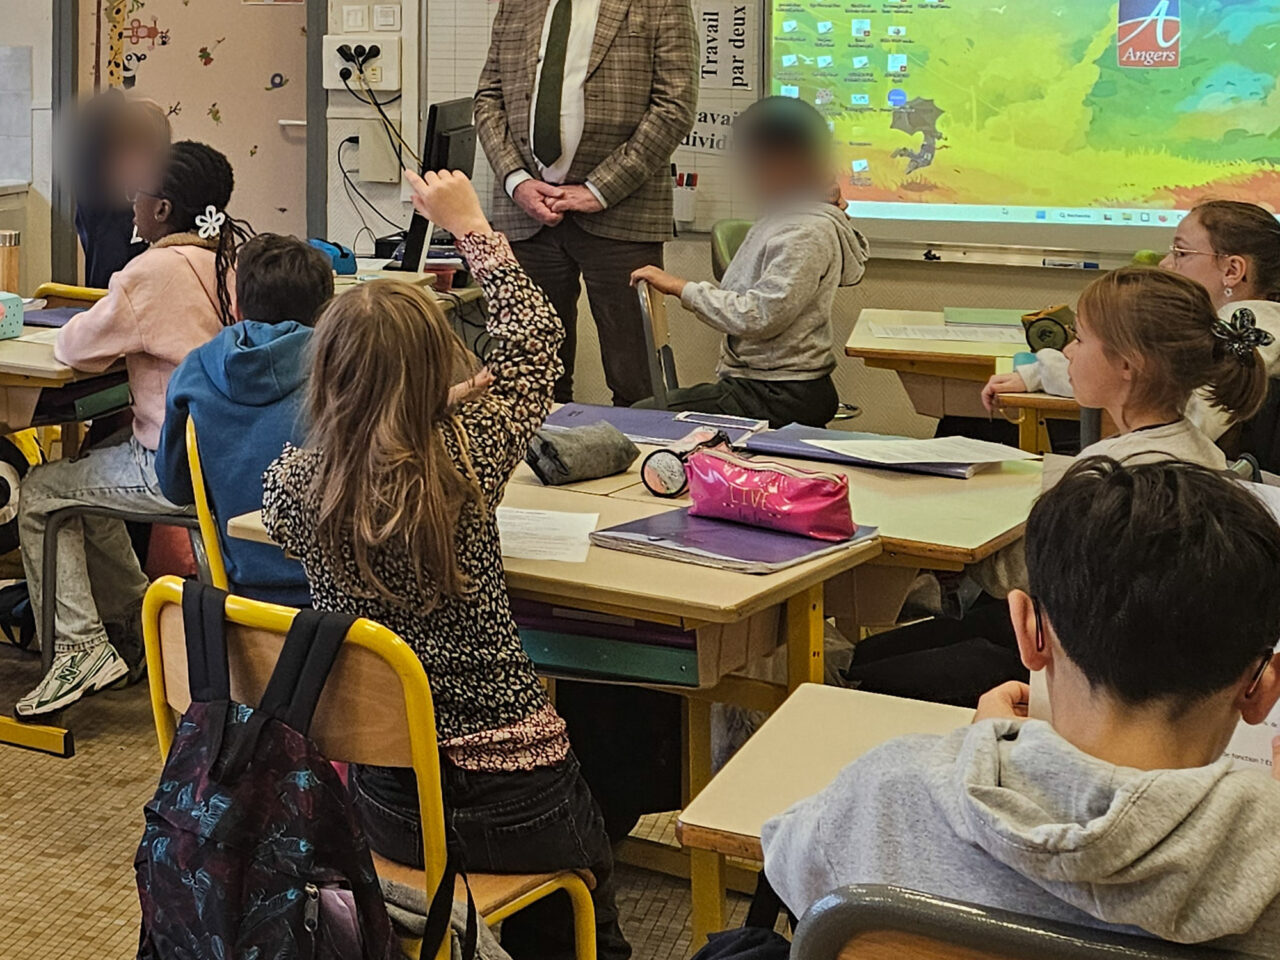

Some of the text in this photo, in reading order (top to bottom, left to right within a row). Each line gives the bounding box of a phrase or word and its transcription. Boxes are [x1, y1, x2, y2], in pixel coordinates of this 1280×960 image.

[701, 11, 719, 79] Travail
[728, 5, 749, 87] par deux
[1122, 47, 1176, 66] Angers
[729, 485, 769, 511] LIVE
